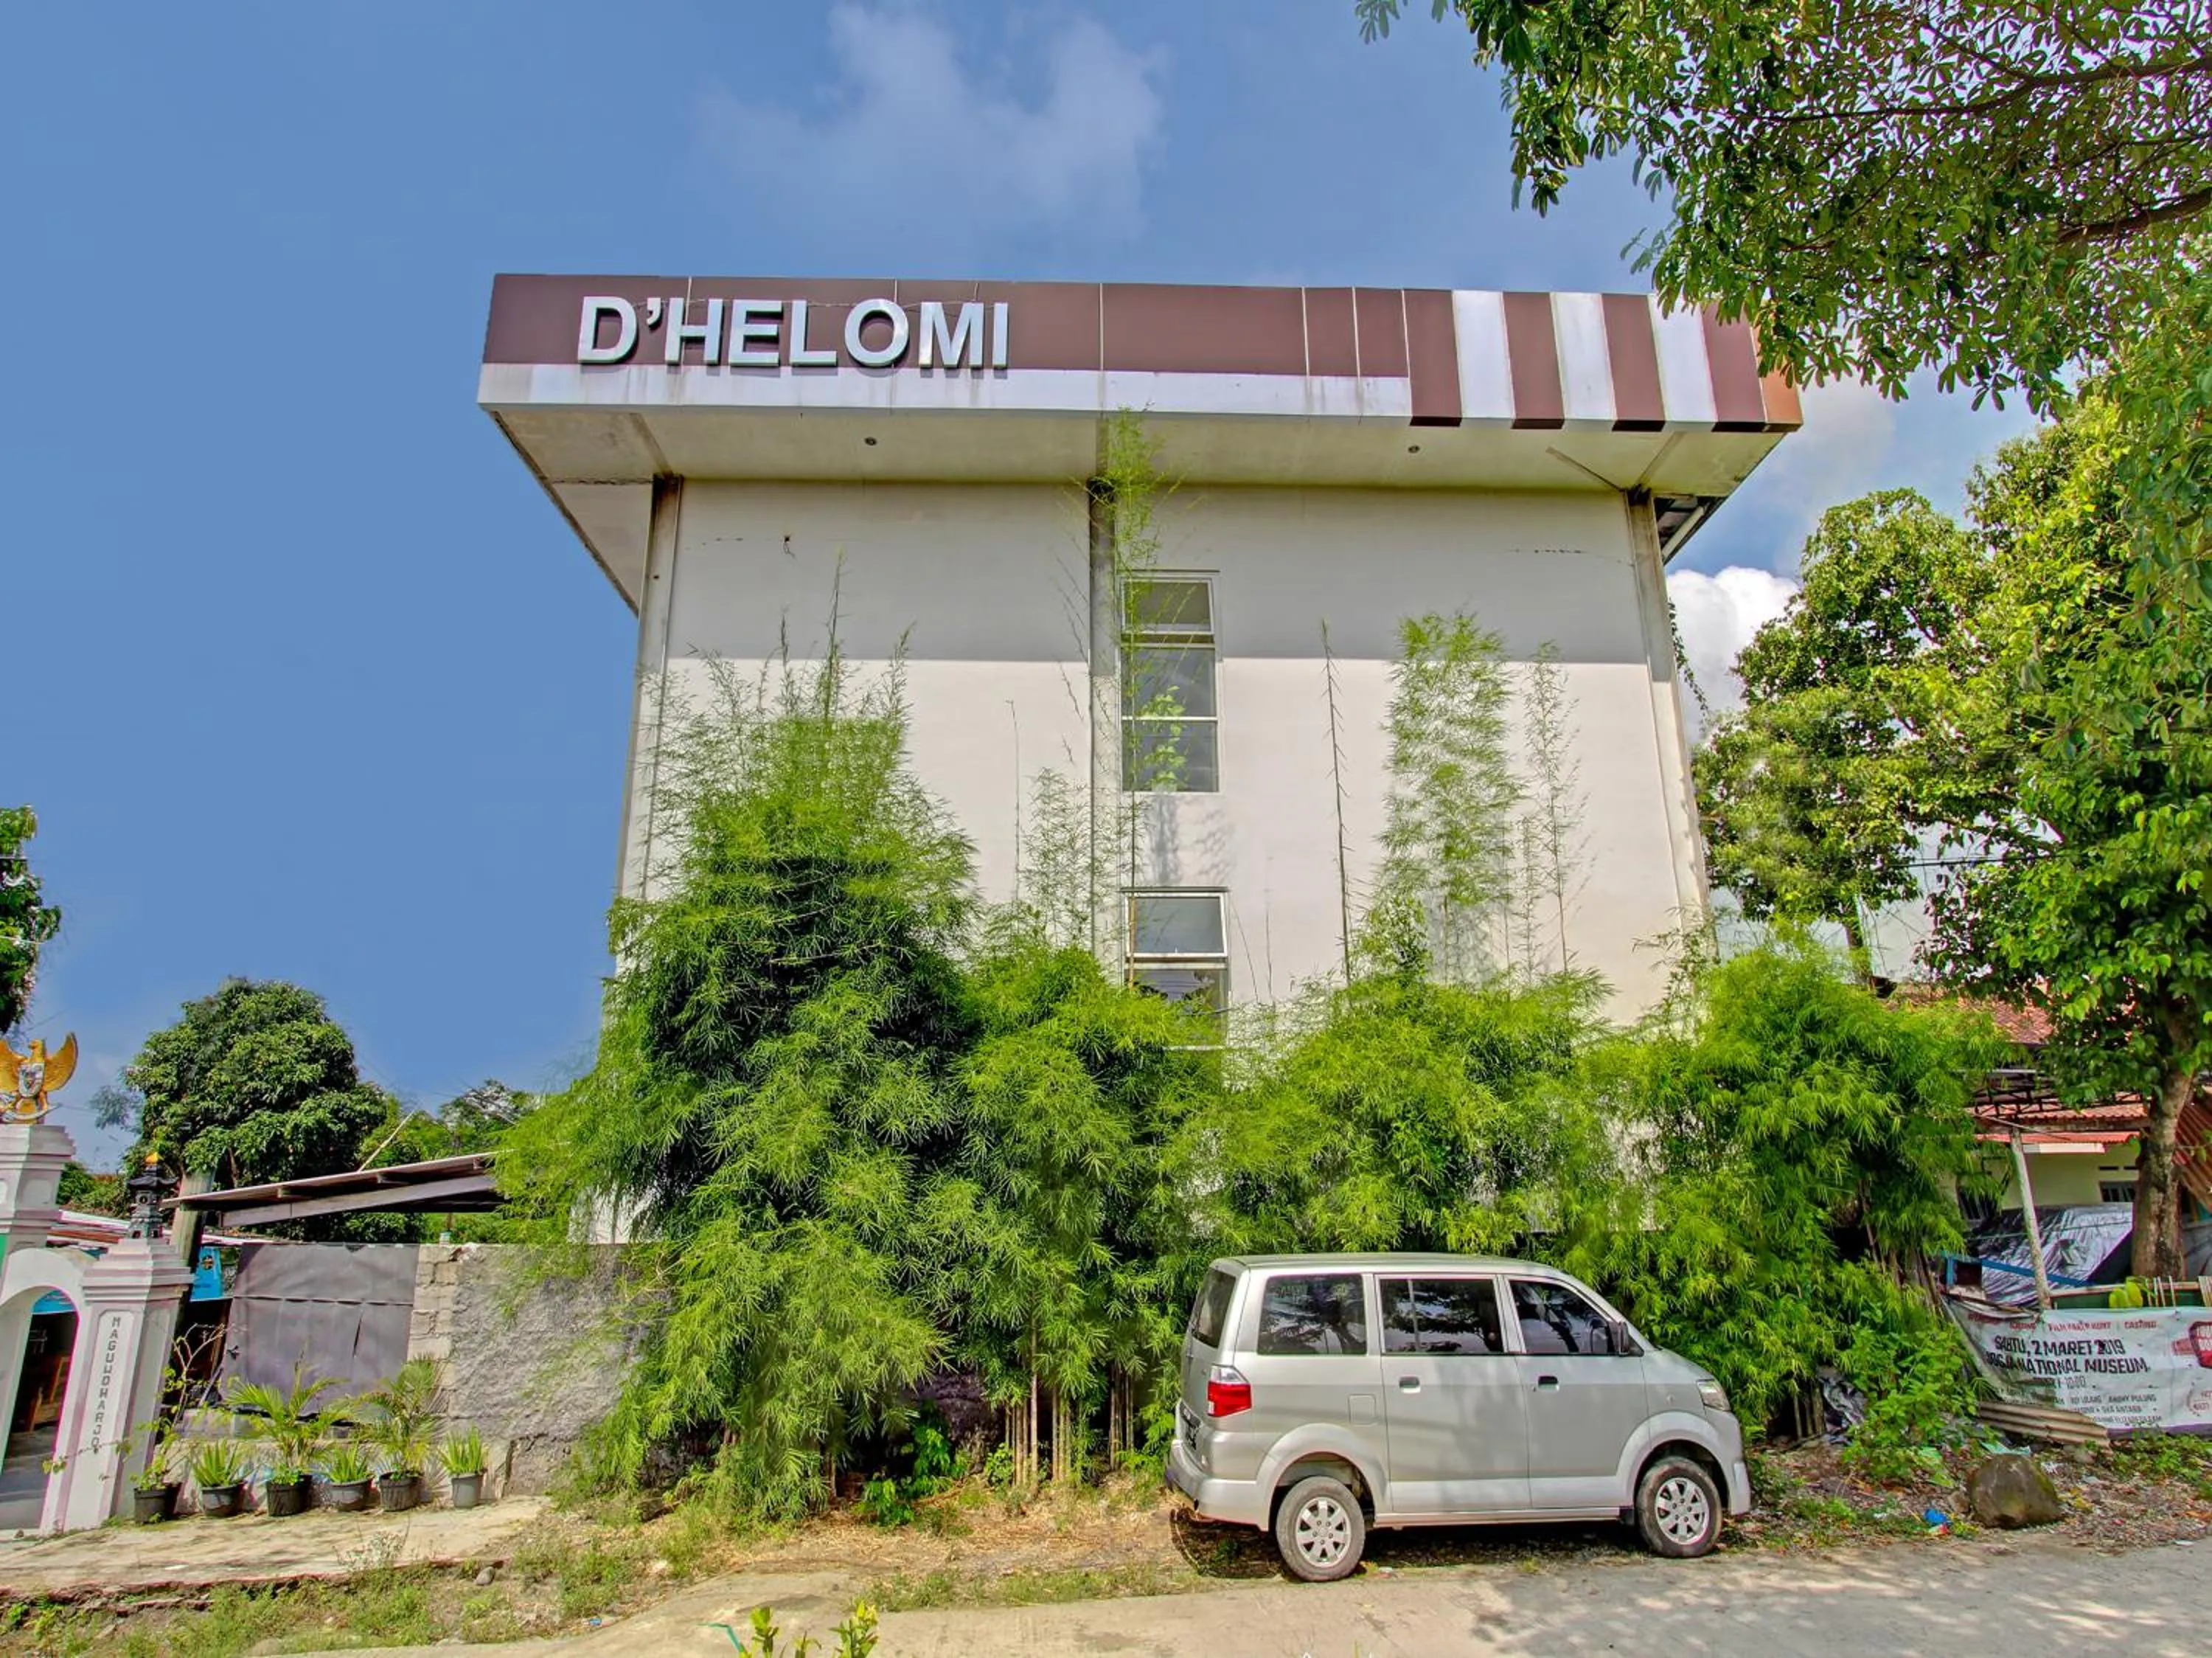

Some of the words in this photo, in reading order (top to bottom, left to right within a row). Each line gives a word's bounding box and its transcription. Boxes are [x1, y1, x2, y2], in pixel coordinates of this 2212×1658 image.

[2031, 1339, 2042, 1356] 2
[2042, 1339, 2093, 1356] MARET
[2093, 1339, 2126, 1356] 2019
[2016, 1358, 2081, 1376] NATIONAL
